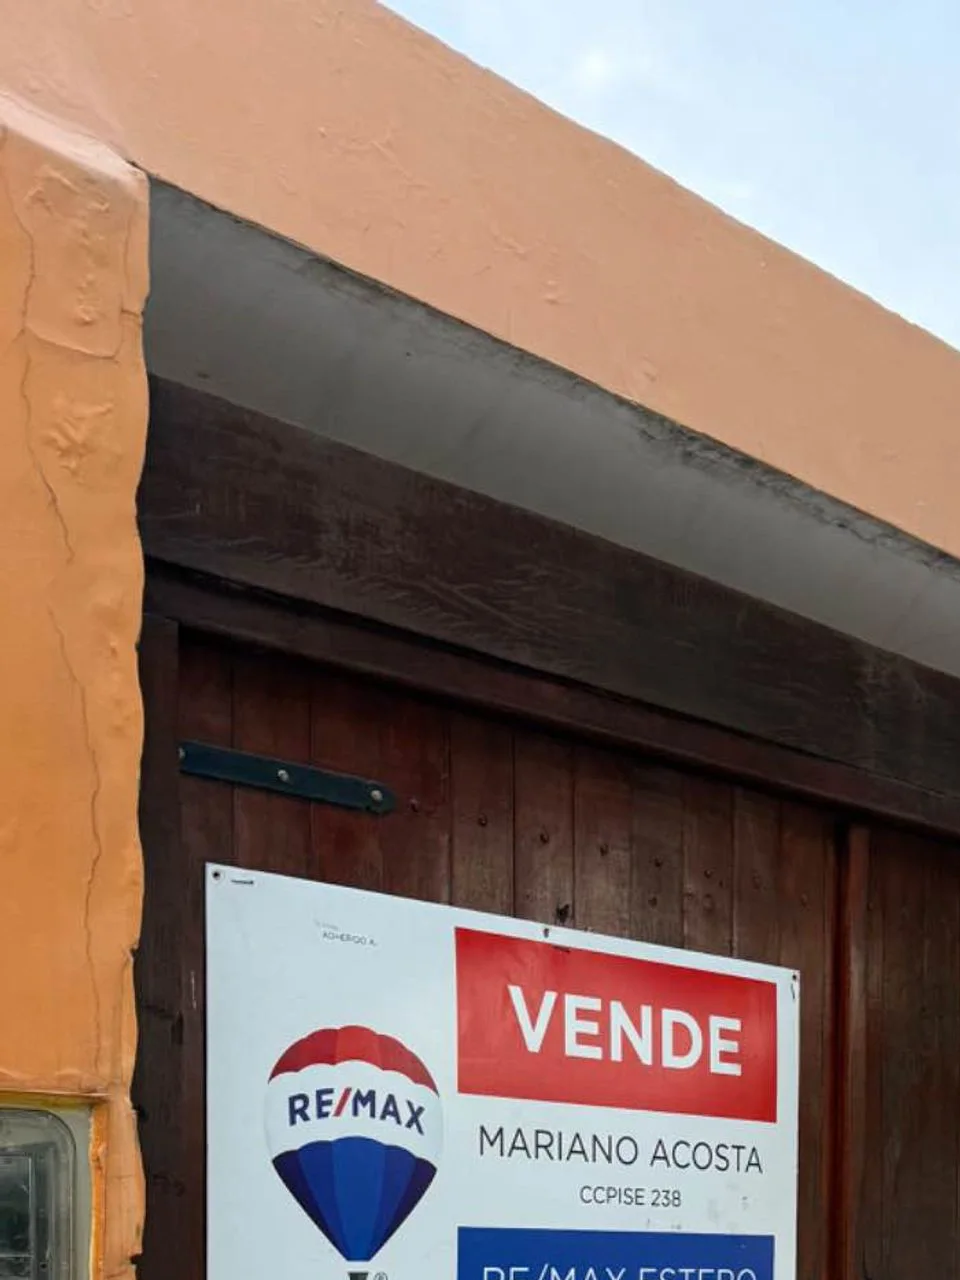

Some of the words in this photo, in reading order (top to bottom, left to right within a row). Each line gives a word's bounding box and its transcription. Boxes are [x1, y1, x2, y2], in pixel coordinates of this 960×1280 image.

[508, 985, 743, 1077] VENDE
[287, 1086, 426, 1136] RE/MAX
[479, 1125, 639, 1166] MARIANO
[650, 1138, 763, 1174] ACOSTA
[580, 1185, 645, 1206] CCPISE
[650, 1189, 682, 1208] 238
